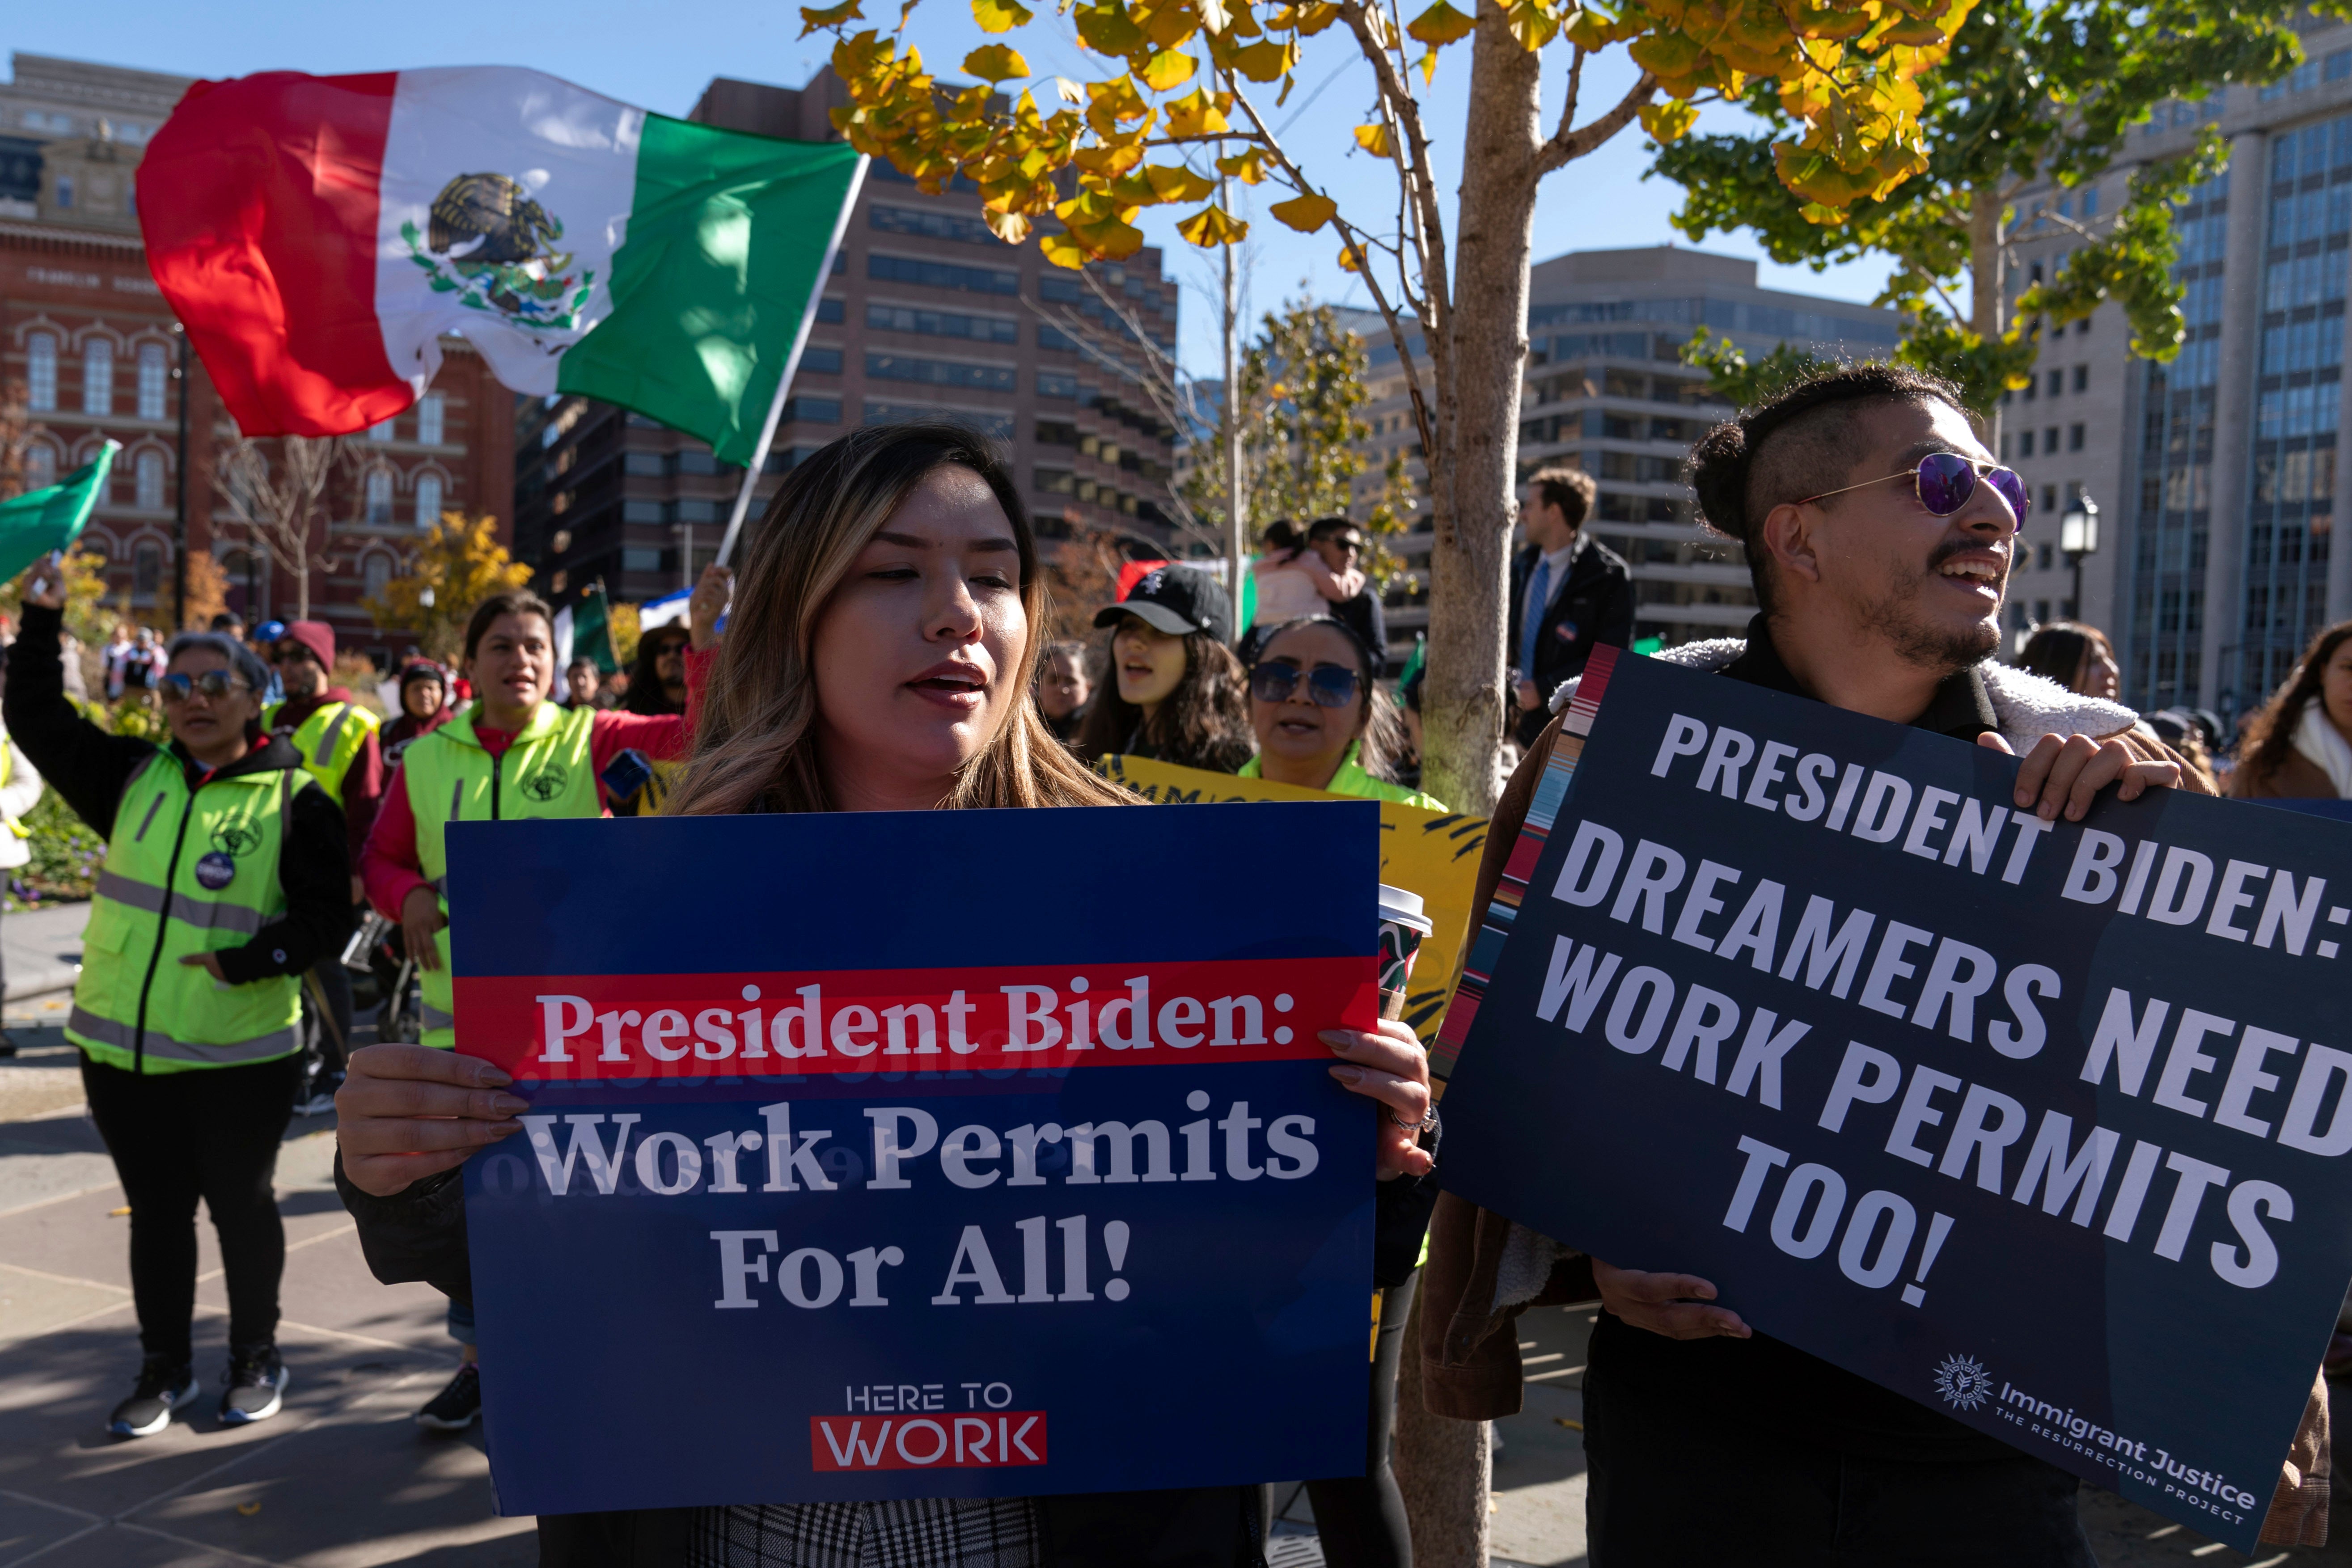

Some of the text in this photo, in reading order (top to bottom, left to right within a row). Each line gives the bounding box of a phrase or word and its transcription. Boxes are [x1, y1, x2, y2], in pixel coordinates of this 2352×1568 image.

[1651, 713, 2351, 959] PRESIDENT BIDEN:
[536, 976, 1294, 1062] President Biden:
[1552, 820, 2352, 1157] DREAMERS NEED
[516, 1102, 838, 1196] Work
[864, 1090, 1319, 1189] Permits
[1536, 934, 2293, 1288] WORK PERMITS
[711, 1214, 1129, 1309] For All!
[1723, 1135, 1954, 1307] TOO!
[820, 1416, 1039, 1467] WORK
[846, 1382, 1012, 1412] HERE TO
[2000, 1382, 2255, 1509] Immigrant Justice
[1996, 1407, 2243, 1525] THE RESURRECTION PROJECT
